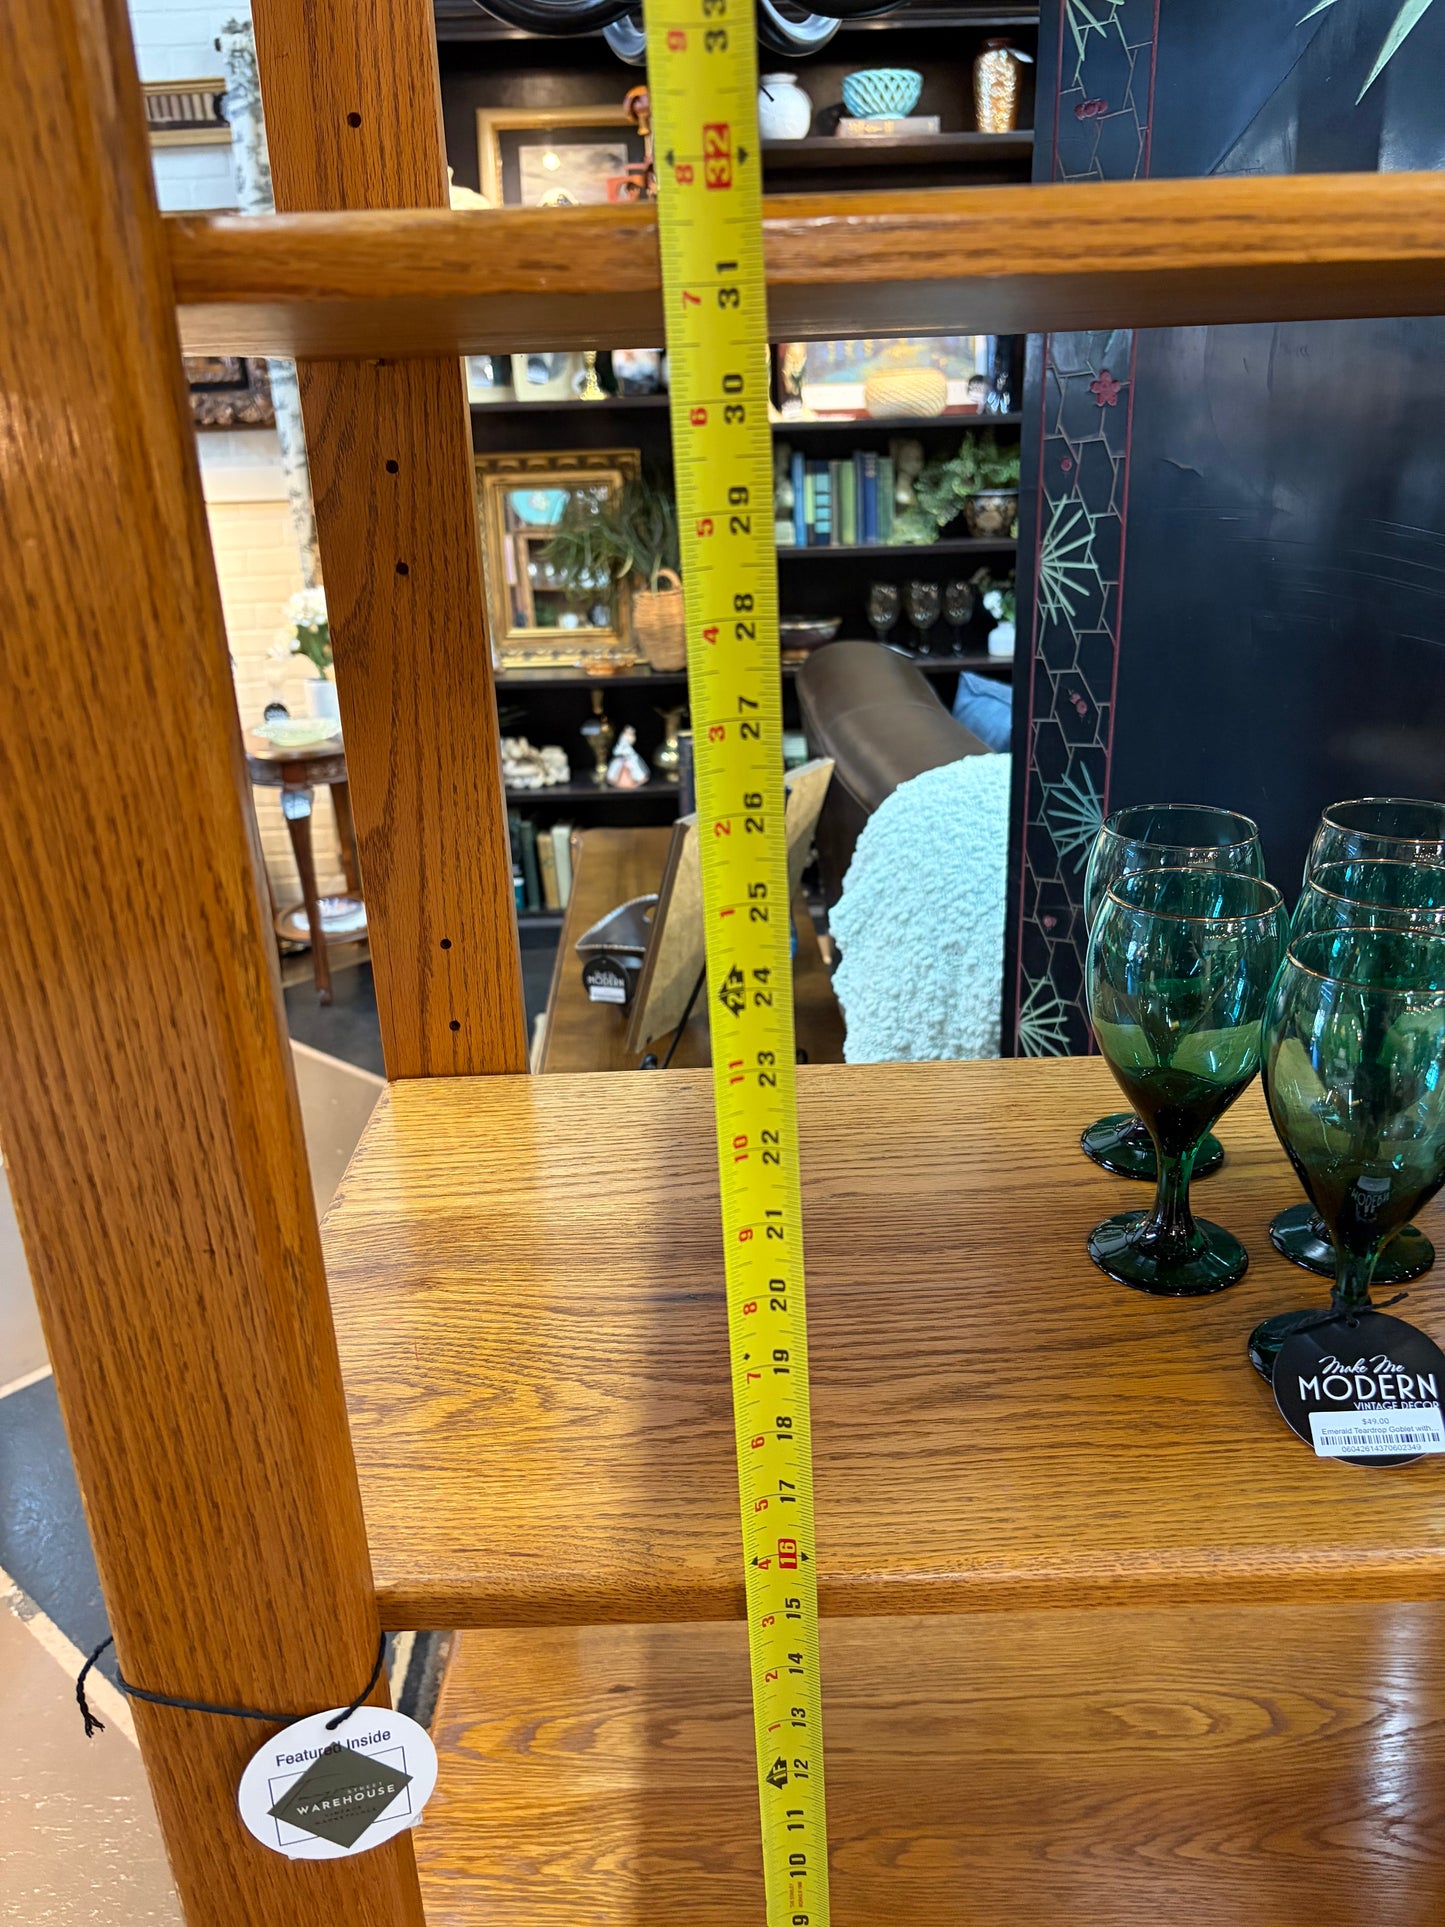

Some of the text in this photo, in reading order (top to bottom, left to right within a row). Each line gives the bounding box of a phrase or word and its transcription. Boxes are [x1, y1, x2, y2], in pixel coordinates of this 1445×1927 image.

[704, 126, 729, 186] 32
[675, 164, 694, 184] 8
[717, 263, 739, 307] 31
[682, 290, 702, 309] 7
[724, 375, 744, 423] 30
[690, 407, 708, 426] 6
[729, 487, 750, 533] 29
[697, 518, 714, 537] 5
[735, 594, 755, 639] 28
[702, 627, 720, 644] 4
[739, 697, 759, 738] 27
[709, 725, 725, 742] 3
[745, 793, 763, 832] 26
[714, 822, 731, 836] 2
[750, 884, 767, 921] 25
[720, 909, 735, 918] 1
[754, 969, 771, 1005] 24
[728, 1060, 744, 1084] 11
[758, 1052, 775, 1086] 23
[733, 1135, 749, 1162] 10
[762, 1131, 779, 1164] 22
[738, 1228, 754, 1242] 9
[766, 1212, 783, 1239] 21
[770, 1280, 786, 1311] 20
[743, 1301, 758, 1315] 8
[773, 1350, 789, 1373] 19
[1318, 1354, 1405, 1375] Make Me
[746, 1373, 761, 1383] 7
[1298, 1373, 1439, 1401] MODERN
[1353, 1401, 1397, 1411] VINTAGE
[776, 1417, 792, 1440] 18
[1321, 1428, 1353, 1436] Emerald
[1354, 1427, 1388, 1435] Teardrop
[1388, 1425, 1414, 1433] Goblet
[1362, 1417, 1390, 1426] $49.00
[751, 1436, 765, 1449] 6
[779, 1480, 795, 1502] 17
[754, 1499, 768, 1512] 5
[779, 1541, 796, 1565] 16
[757, 1559, 772, 1570] 4
[785, 1598, 801, 1618] 15
[762, 1616, 775, 1628] 3
[788, 1653, 803, 1673] 14
[765, 1671, 778, 1683] 2
[768, 1722, 781, 1733] 1
[791, 1708, 806, 1727] 13
[276, 1729, 391, 1767] Featured Inside
[794, 1759, 808, 1778] 12
[296, 1784, 395, 1815] WAREHOUSE
[787, 1810, 804, 1831] 11
[789, 1854, 806, 1877] 10
